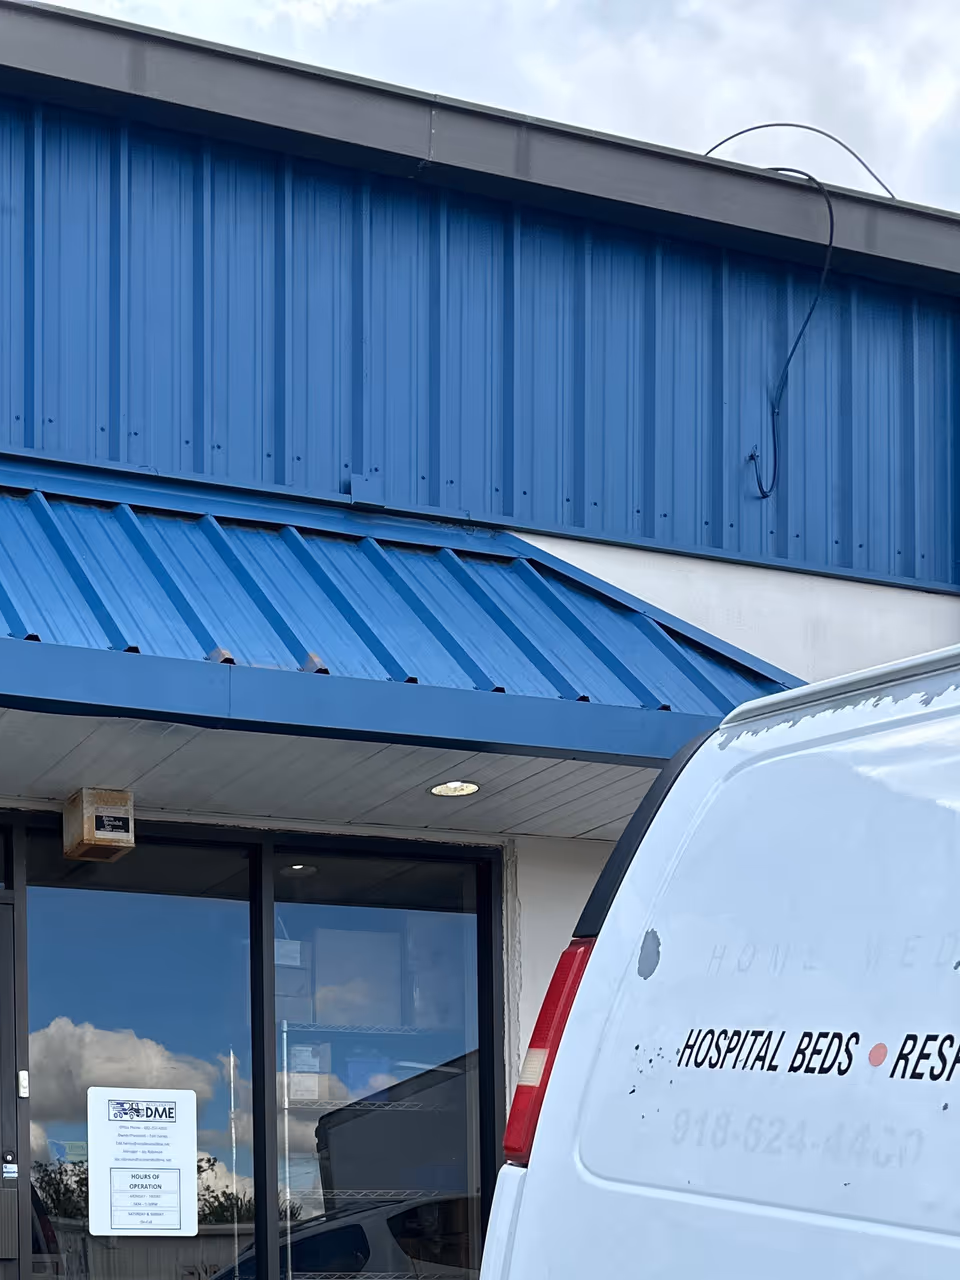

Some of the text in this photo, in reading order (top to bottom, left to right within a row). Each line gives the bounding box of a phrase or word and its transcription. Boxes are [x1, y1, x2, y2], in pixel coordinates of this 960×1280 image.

[677, 1029, 787, 1071] HOSPITAL
[788, 1031, 861, 1076] BEDS
[145, 1106, 175, 1119] DME
